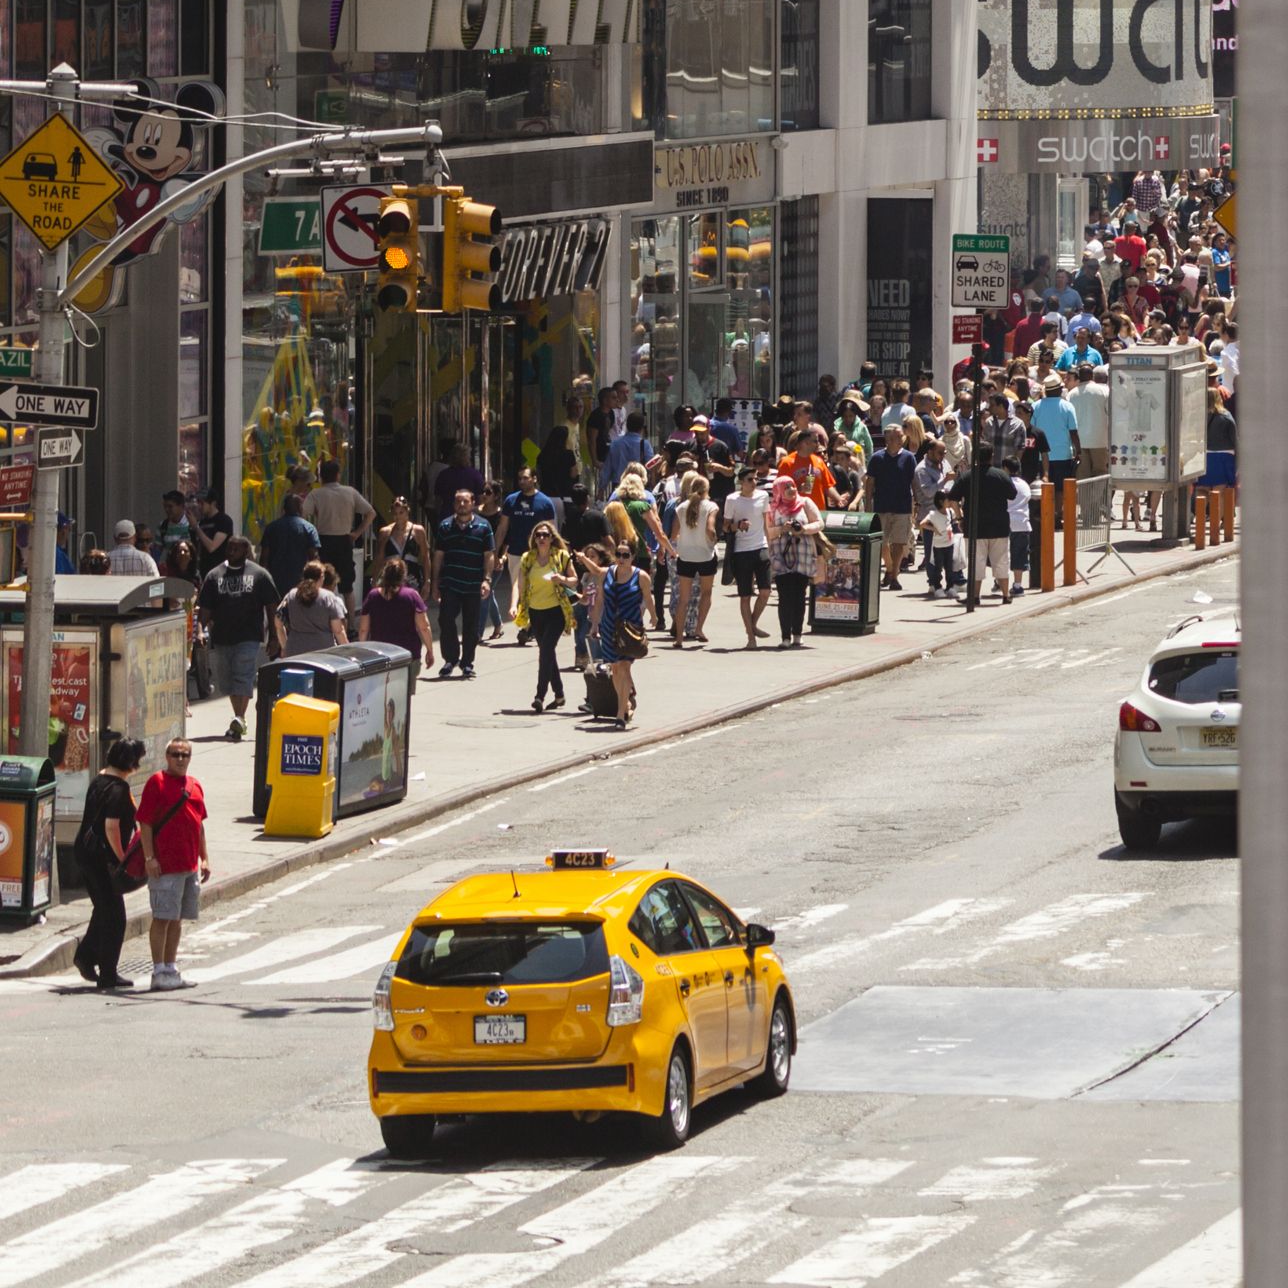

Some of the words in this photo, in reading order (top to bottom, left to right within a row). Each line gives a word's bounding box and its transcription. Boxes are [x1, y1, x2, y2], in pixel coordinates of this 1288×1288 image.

[1037, 129, 1154, 163] swatch
[691, 145, 723, 185] POLO
[28, 183, 81, 200] SHARE
[675, 188, 703, 208] SINCE
[44, 202, 63, 213] THE
[33, 215, 73, 231] ROAD
[294, 209, 307, 242] 7
[956, 238, 979, 249] BIKE
[982, 238, 1006, 249] ROUTE
[957, 275, 1005, 288] SHARED
[963, 290, 997, 302] LANE
[882, 342, 911, 360] SHOP
[1126, 357, 1152, 365] TITAN
[15, 395, 45, 412] ONE
[53, 398, 85, 417] WAY
[42, 437, 57, 457] ONE
[58, 437, 74, 456] WAY
[283, 743, 322, 758] EPOCH
[284, 753, 322, 767] TIMES
[564, 852, 596, 867] 4C23
